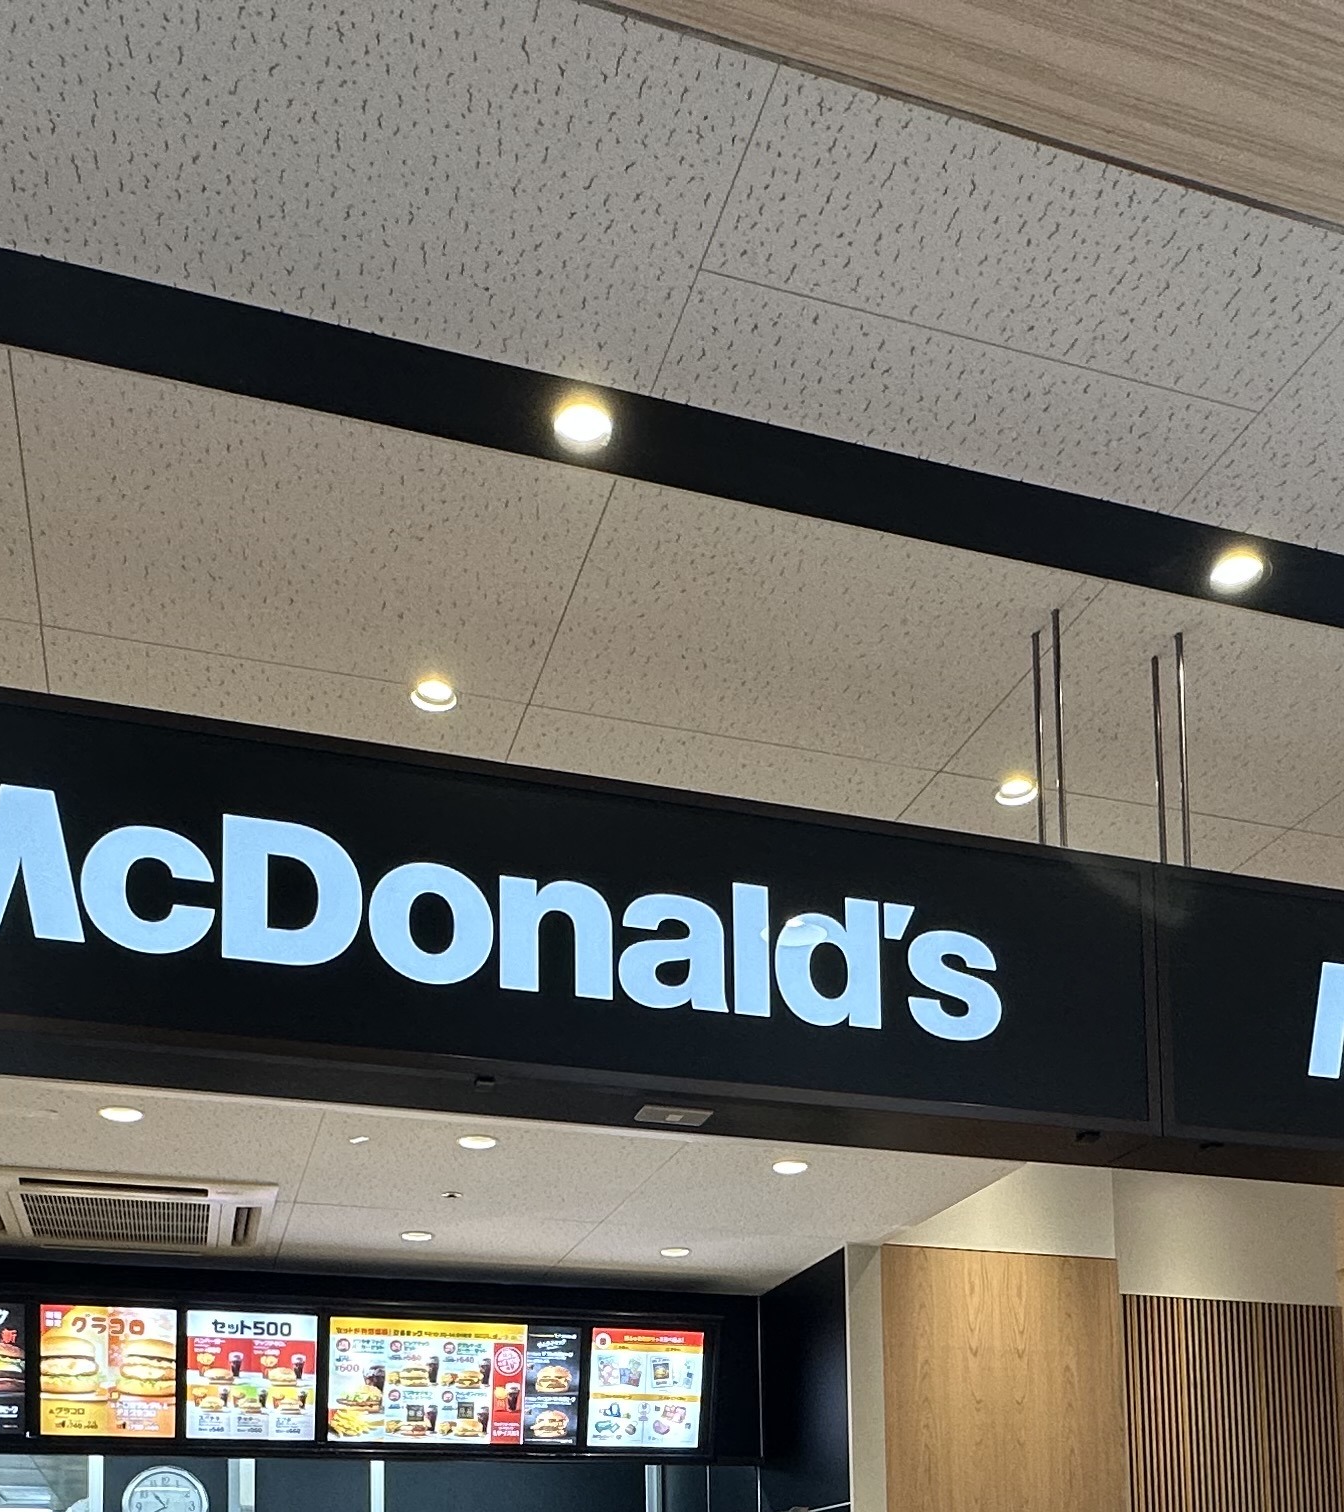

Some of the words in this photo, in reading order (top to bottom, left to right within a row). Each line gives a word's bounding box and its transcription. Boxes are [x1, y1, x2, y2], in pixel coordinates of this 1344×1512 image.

[71, 1313, 146, 1336] グラコロ
[211, 1318, 293, 1337] セット500
